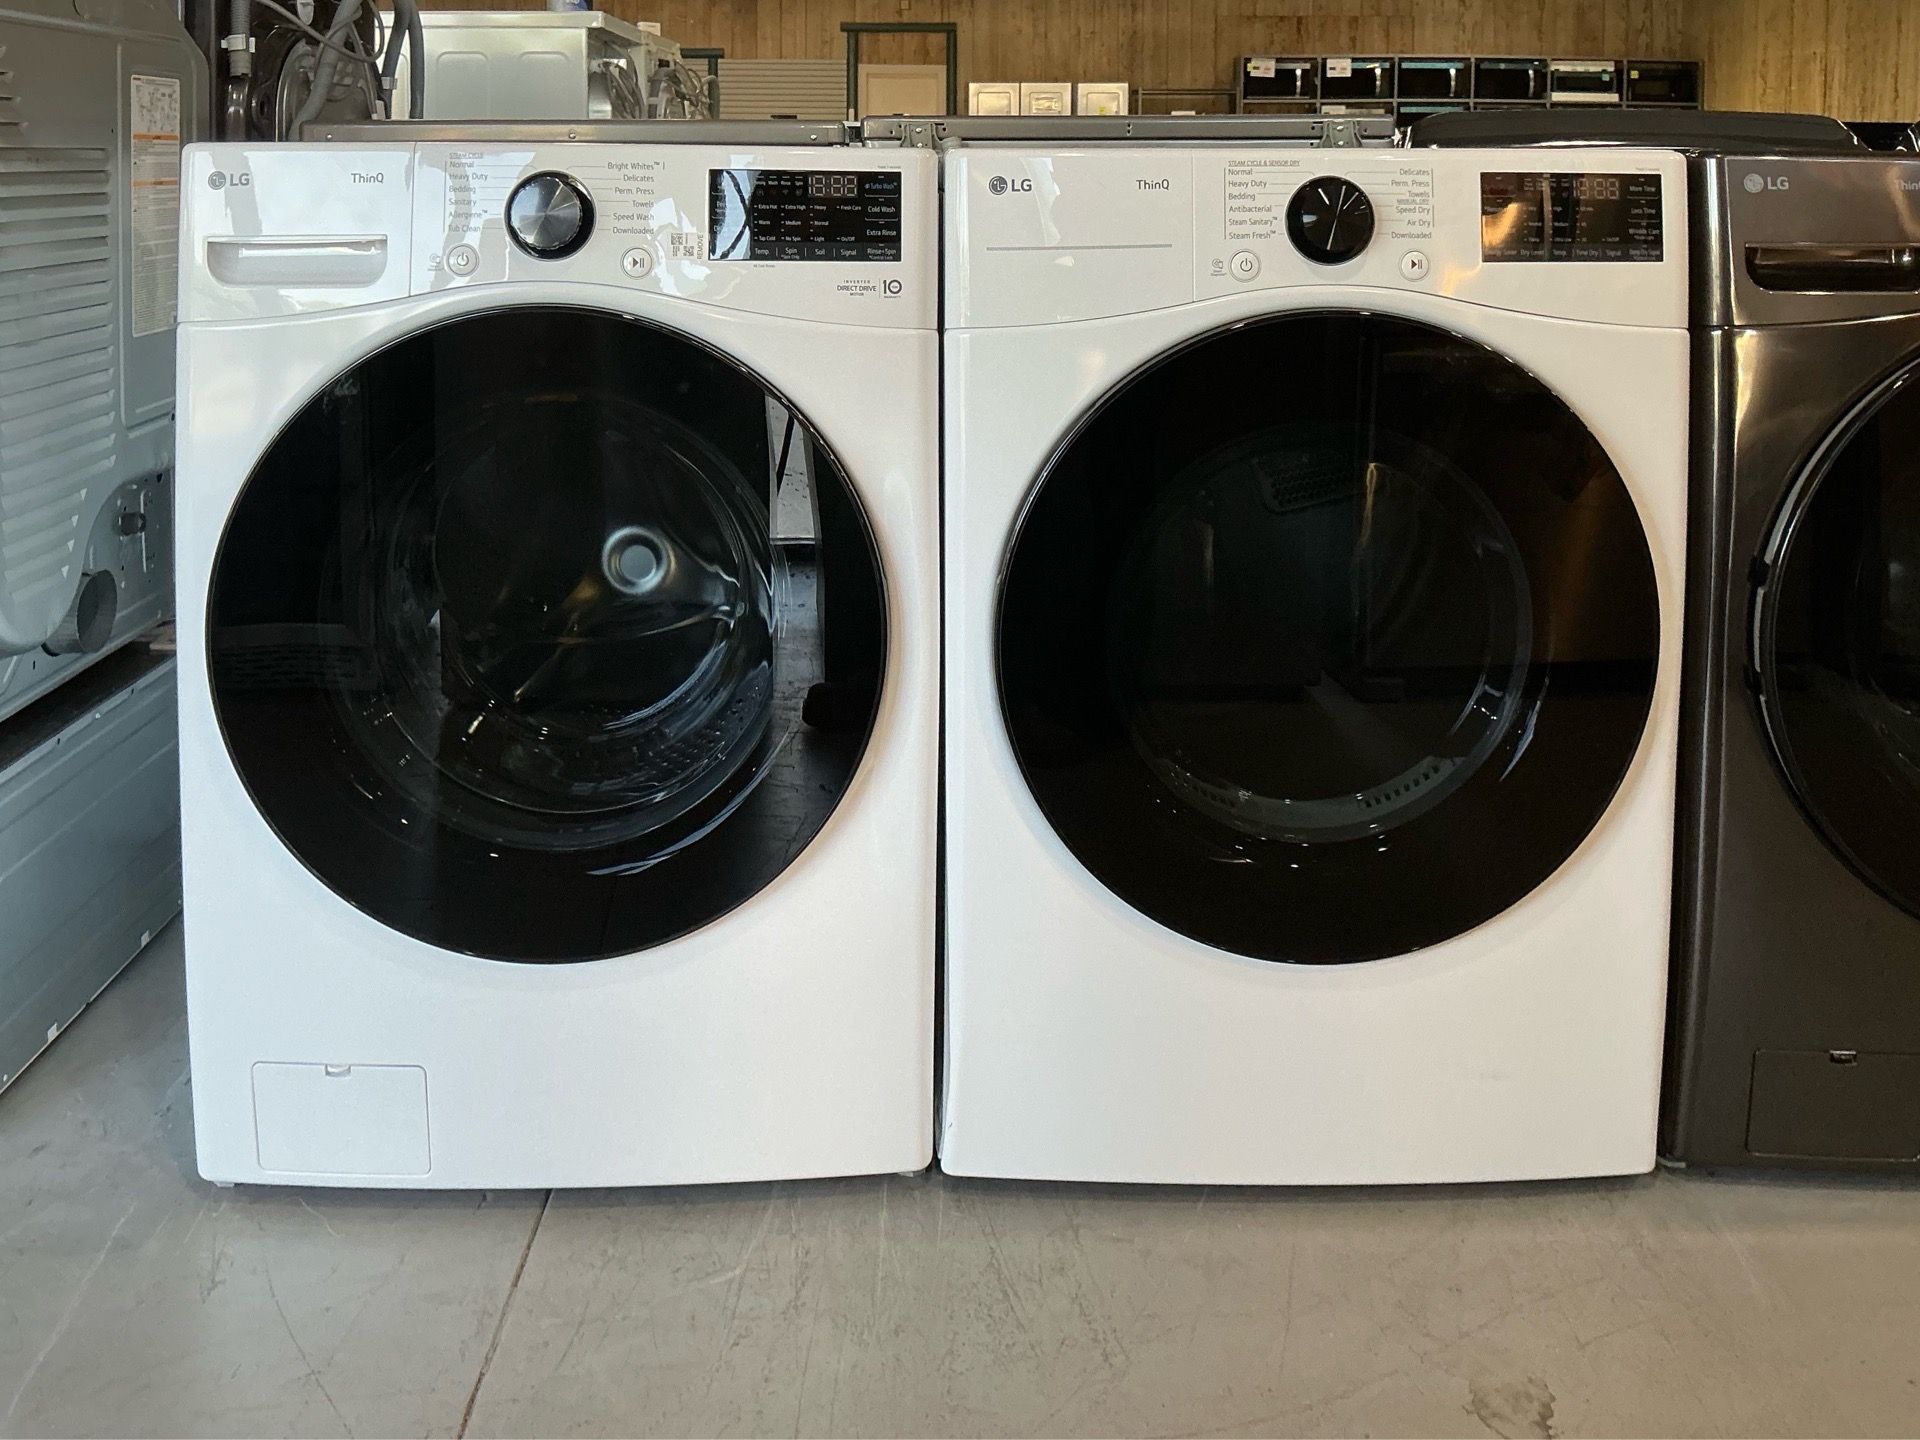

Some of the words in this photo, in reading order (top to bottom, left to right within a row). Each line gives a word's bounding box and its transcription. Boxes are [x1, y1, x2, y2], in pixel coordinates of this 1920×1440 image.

[449, 161, 475, 169] Normal
[608, 162, 628, 171] Bright
[1228, 168, 1252, 176] Normal
[1400, 168, 1429, 176] Delicates
[230, 173, 250, 186] LG
[351, 172, 384, 184] ThinQ
[449, 173, 469, 182] Heavy
[472, 173, 488, 181] Duty
[623, 174, 654, 182] Delicates
[1011, 179, 1032, 192] LG
[1136, 179, 1170, 191] ThinQ
[1228, 180, 1248, 188] Heavy
[1251, 180, 1267, 188] Duty
[1767, 176, 1789, 190] LG
[449, 186, 476, 194] Bedding
[1408, 190, 1429, 198] Towels
[1229, 193, 1255, 201] Bedding
[449, 198, 477, 206] Sanitary
[633, 200, 654, 208] Towels
[1229, 205, 1272, 213] Antibacterial
[613, 213, 634, 221] Speed
[840, 248, 856, 256] Signal
